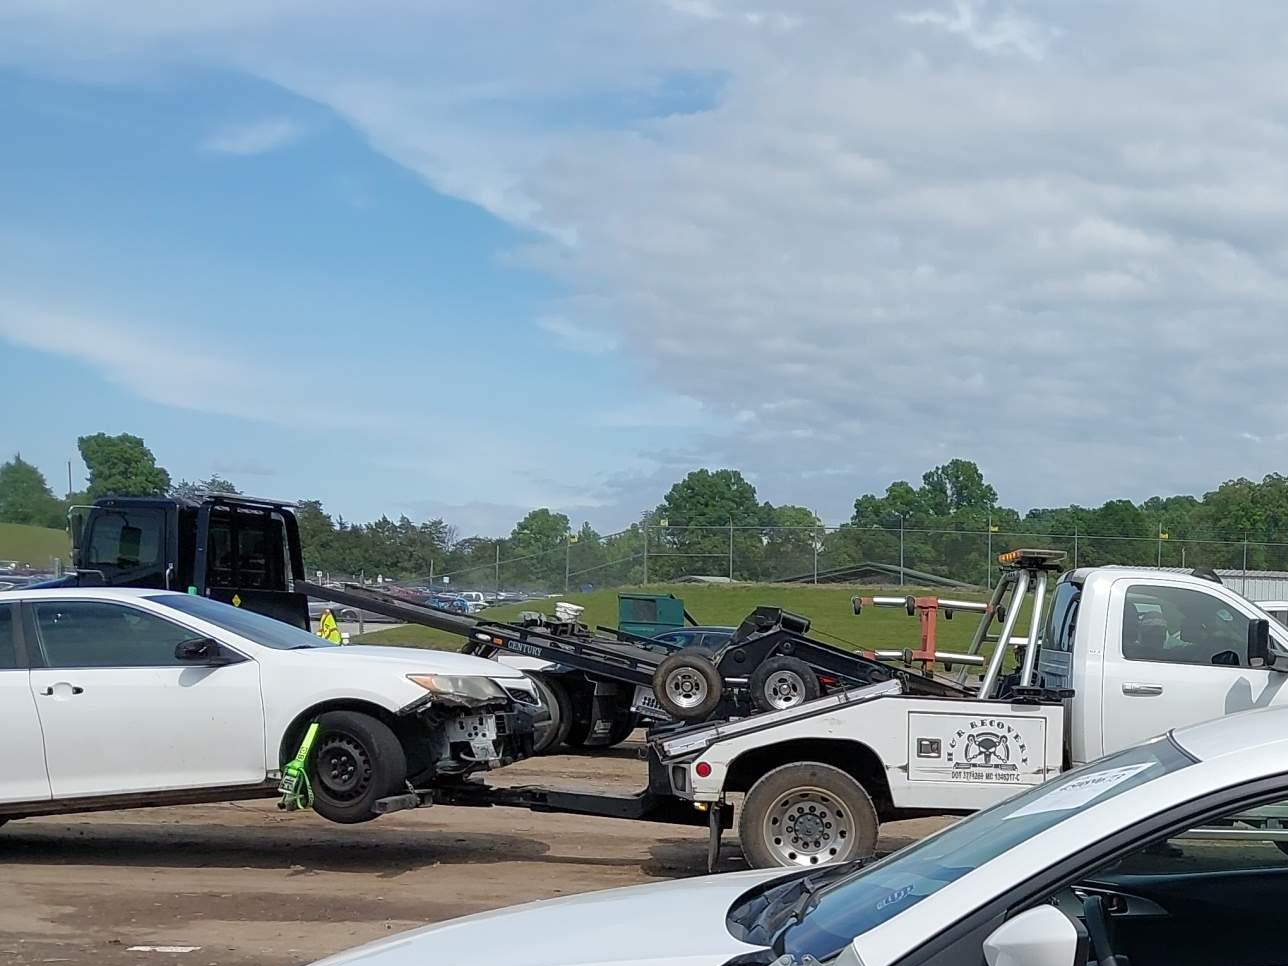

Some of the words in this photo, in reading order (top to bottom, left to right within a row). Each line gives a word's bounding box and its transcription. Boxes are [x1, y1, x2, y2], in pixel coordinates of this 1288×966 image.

[508, 640, 542, 656] CENTURY
[970, 719, 1029, 765] RECOVERY
[951, 770, 962, 779] DOT
